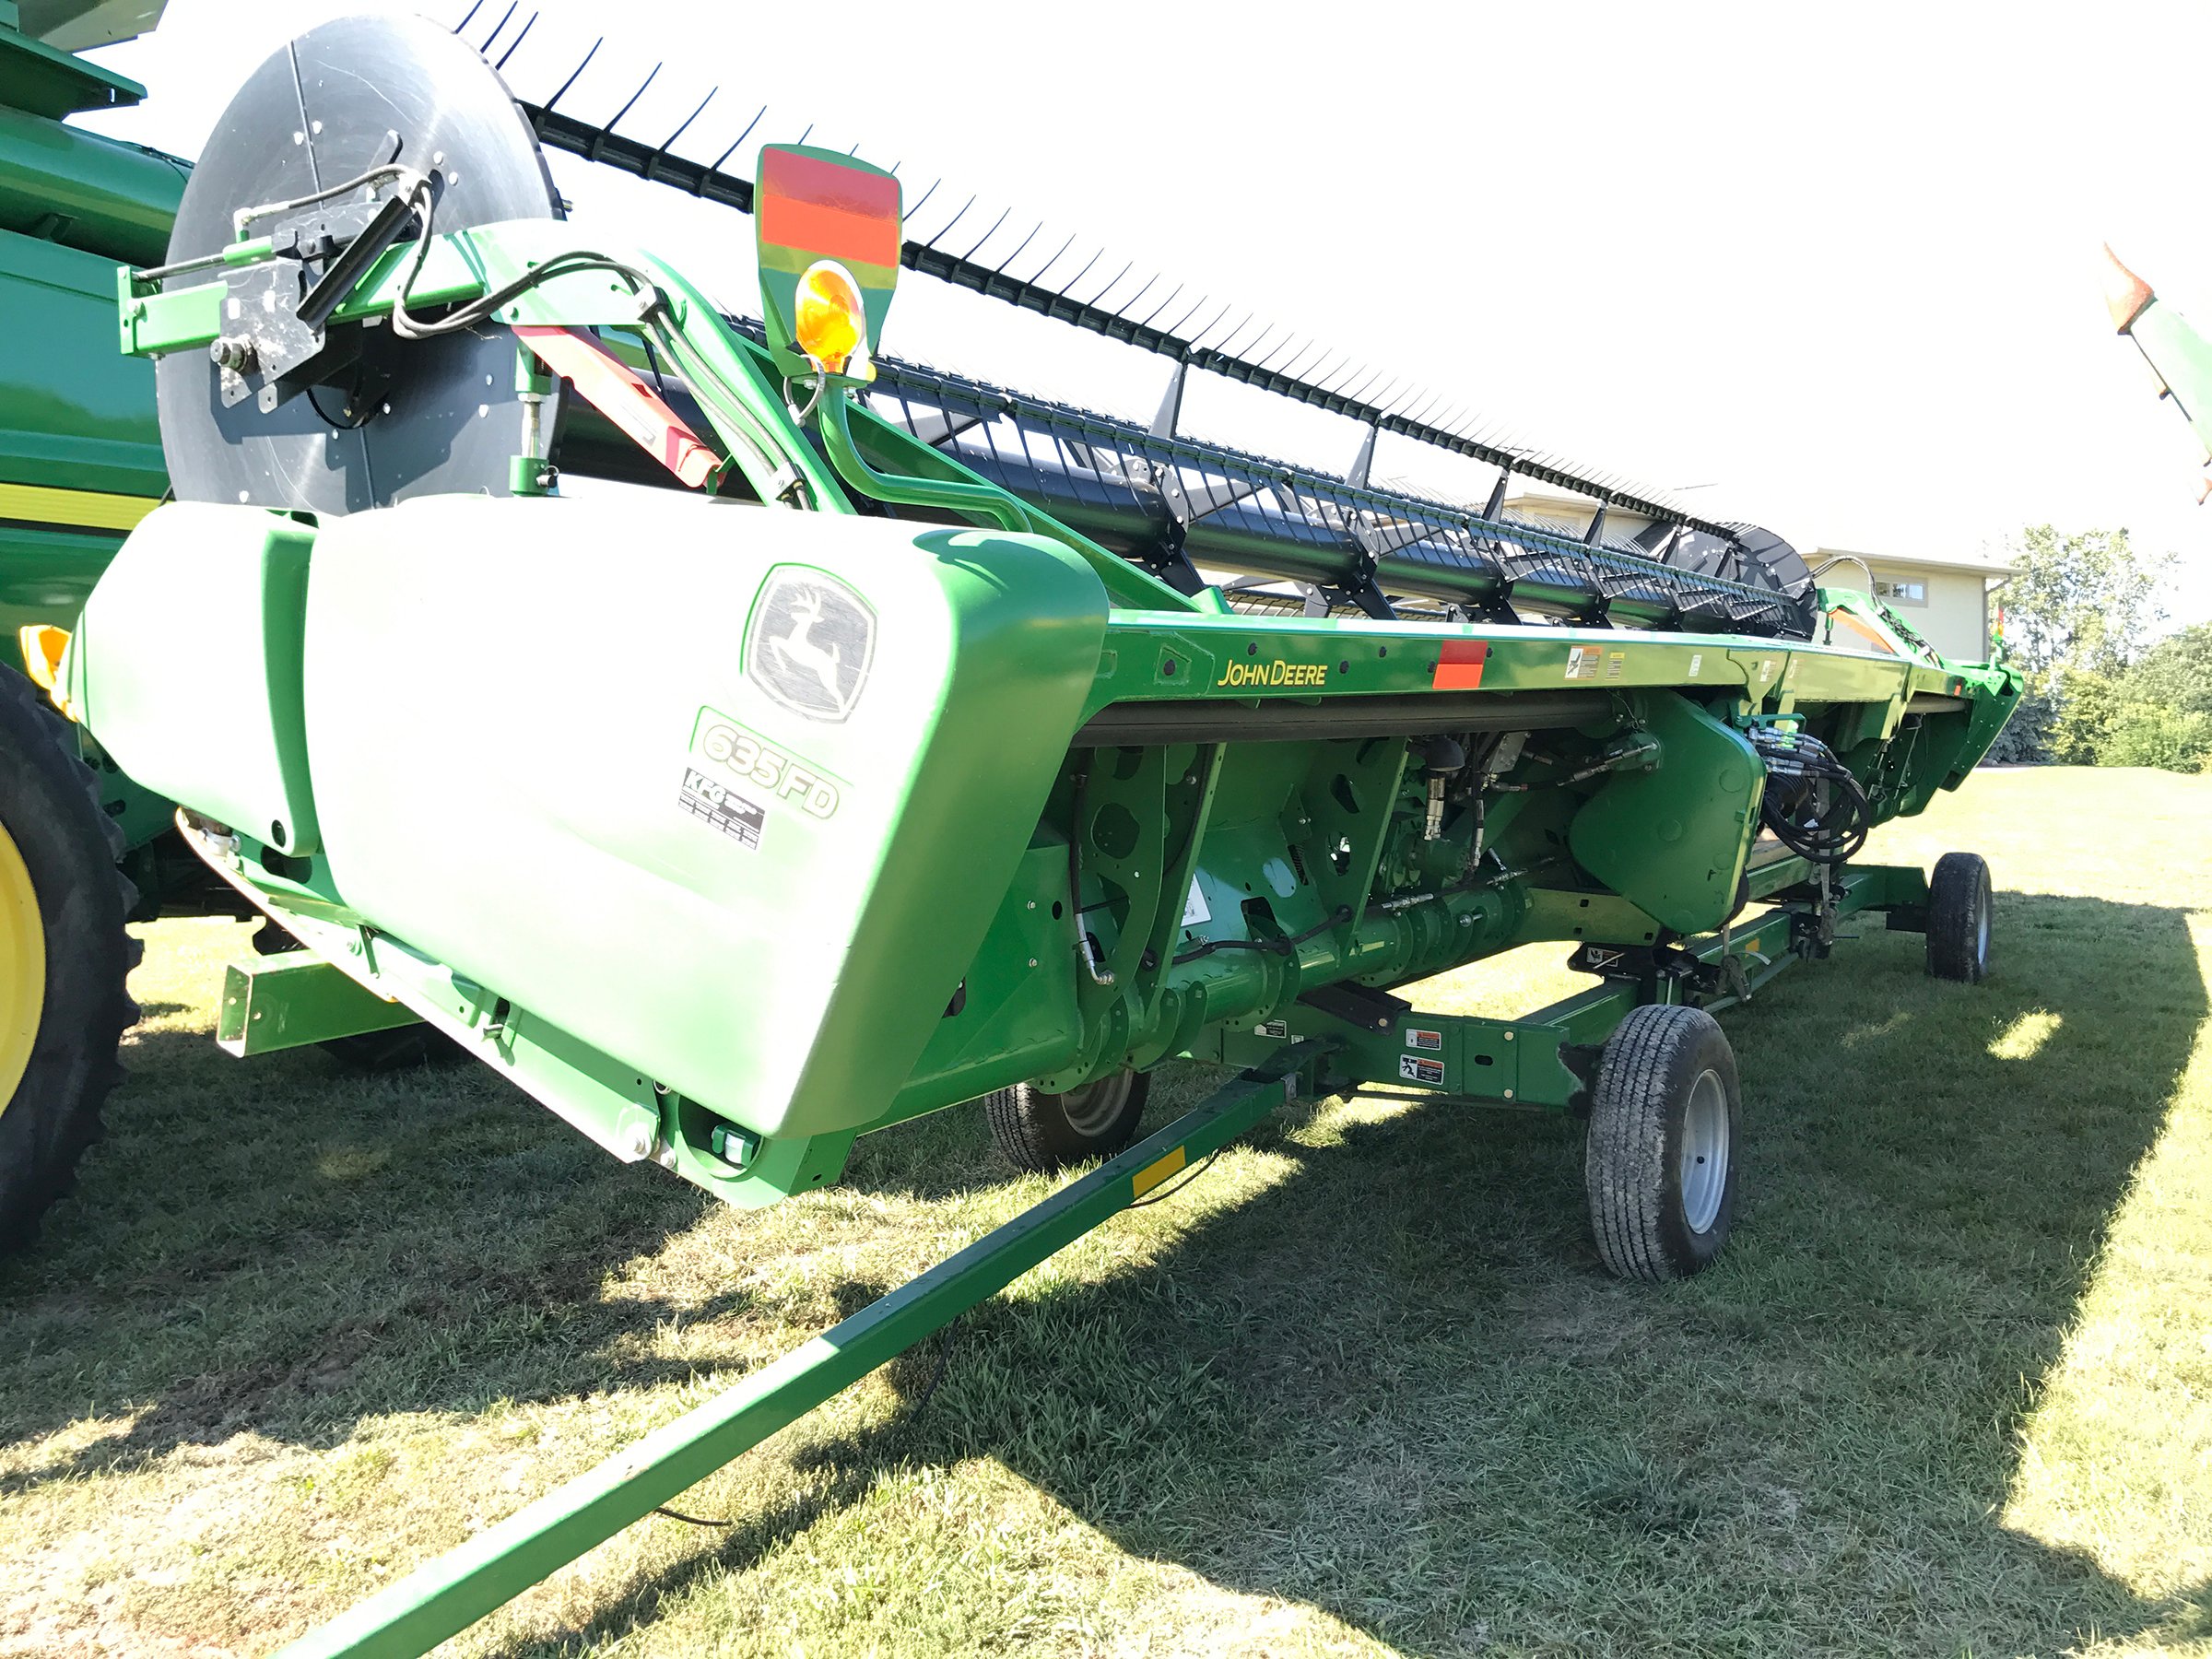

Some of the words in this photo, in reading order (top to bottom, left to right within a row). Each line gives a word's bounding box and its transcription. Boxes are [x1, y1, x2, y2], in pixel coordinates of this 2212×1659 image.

[1217, 659, 1270, 686] JOHN
[1270, 660, 1328, 686] DEERE
[703, 724, 840, 819] 635FD
